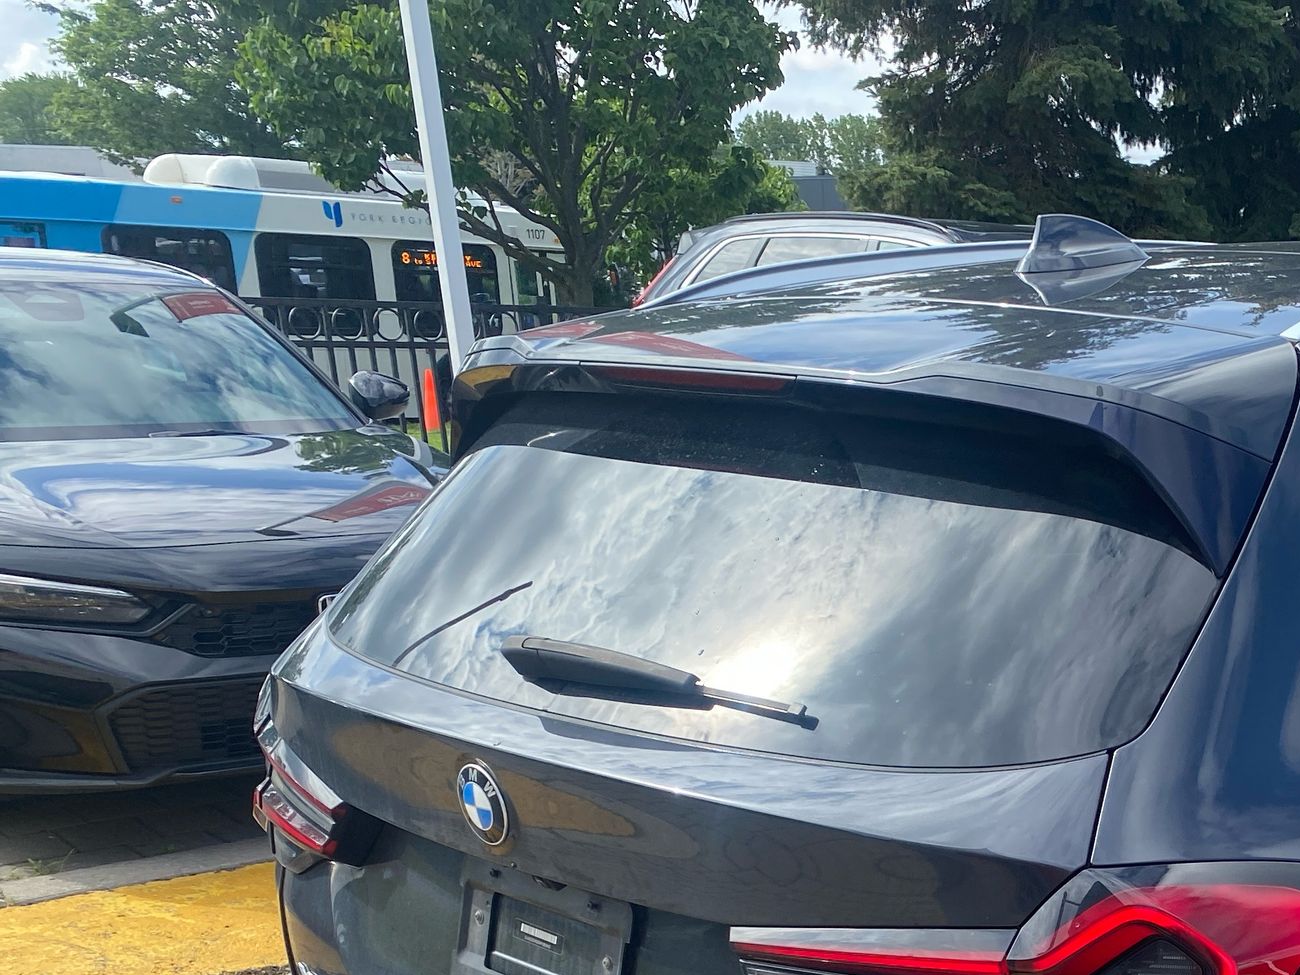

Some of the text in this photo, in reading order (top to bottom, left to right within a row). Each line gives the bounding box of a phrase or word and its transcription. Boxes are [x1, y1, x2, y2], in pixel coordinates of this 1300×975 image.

[351, 213, 432, 226] YORK REGIO
[525, 228, 546, 240] 1107
[401, 251, 411, 264] 8
[414, 257, 423, 265] to
[459, 767, 497, 799] BMW
